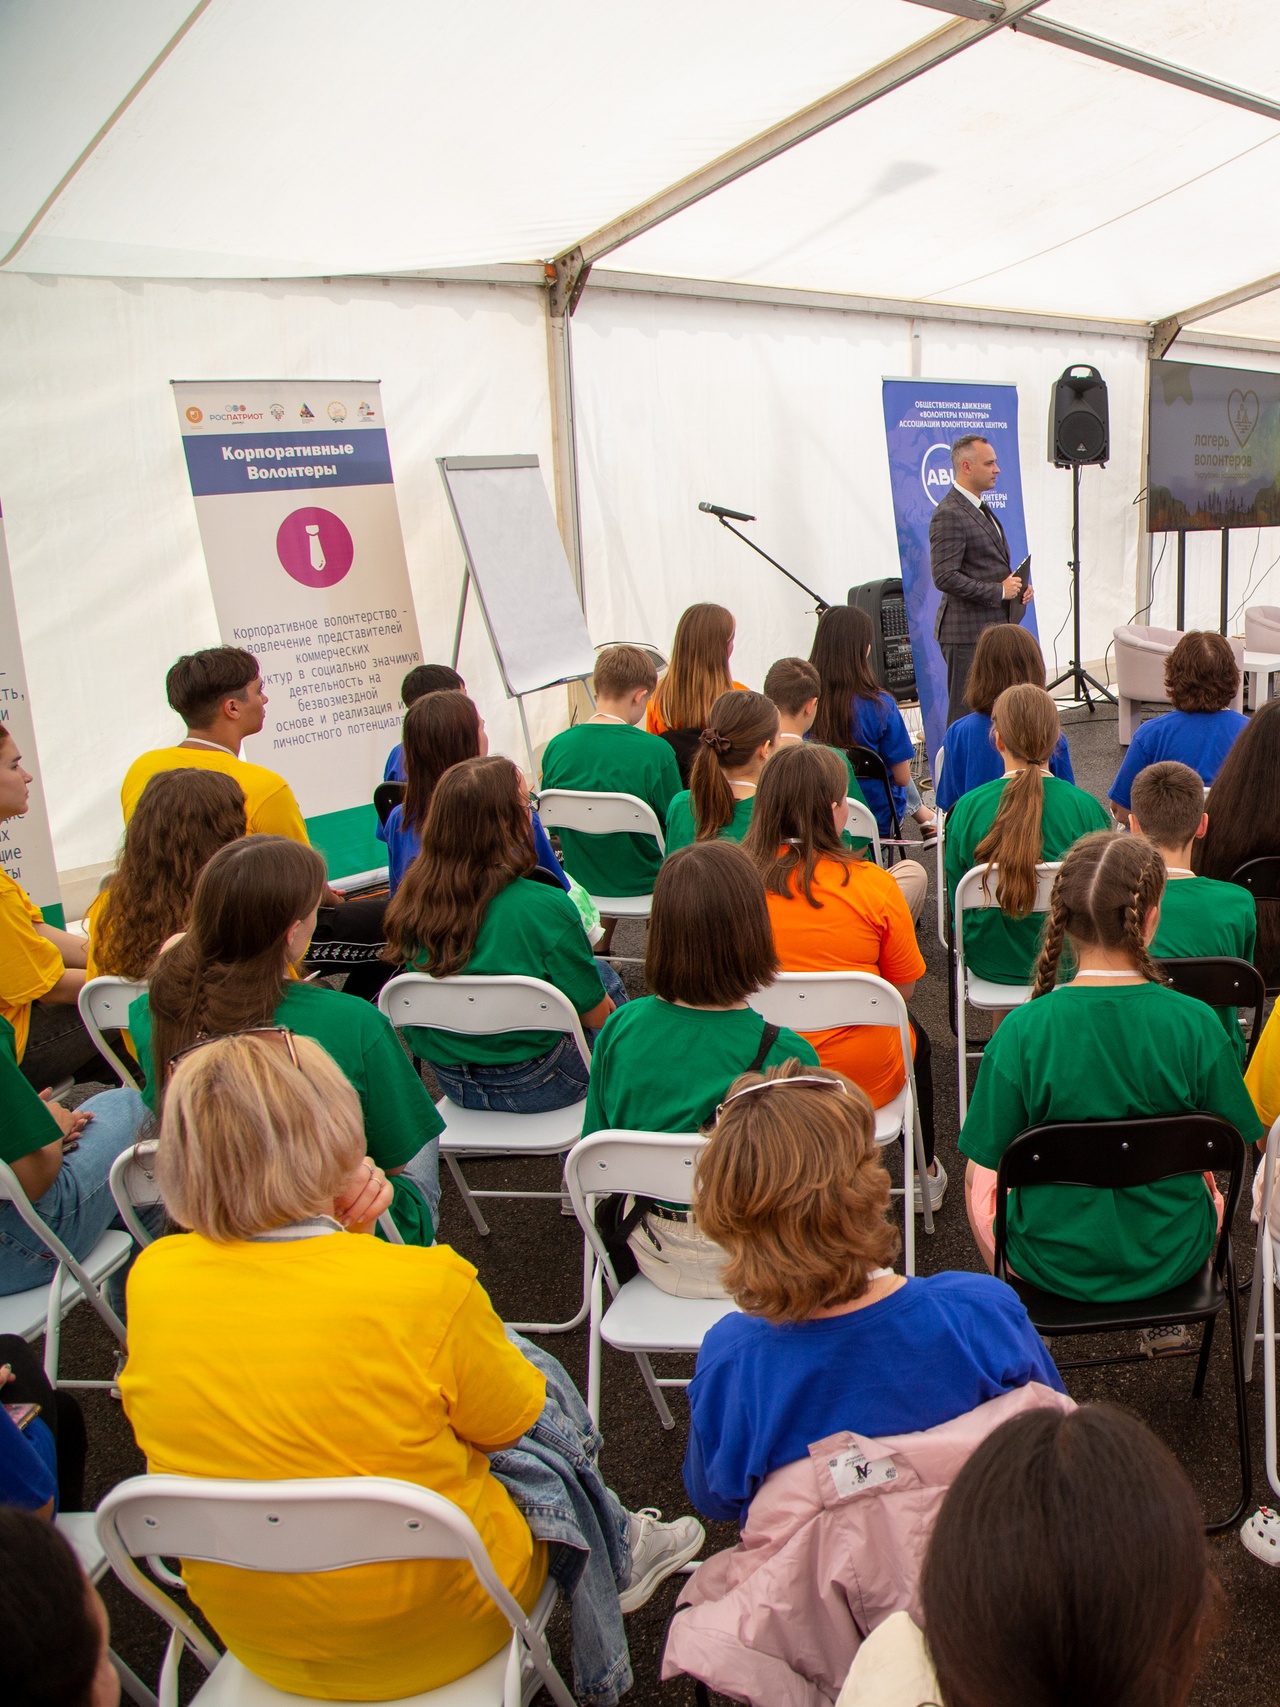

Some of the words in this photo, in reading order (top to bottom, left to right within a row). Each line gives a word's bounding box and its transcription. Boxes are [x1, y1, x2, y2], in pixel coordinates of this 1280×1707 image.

[914, 401, 961, 409] ОБЩЕСТВЕННОЕ
[961, 402, 992, 410] ДВИЖЕНИЕ
[919, 411, 957, 419] «ВОЛОНТЕРЫ
[959, 411, 989, 419] КУЛЬТУРЫ»
[209, 413, 264, 421] РОСПАТРИОТ
[899, 420, 941, 428] АССОЦИАЦИИ
[941, 420, 984, 428] ВОЛОНТЕРСКИХ
[985, 421, 1008, 429] ЦЕНТРОВ
[1194, 434, 1229, 451] лагерь
[221, 444, 354, 462] Корпоративные
[1194, 454, 1252, 470] волонтеров
[247, 464, 337, 480] Волонтеры
[233, 619, 318, 641] Корпоративное
[324, 608, 397, 627] волонтерство
[247, 636, 312, 654] вовлечение
[318, 621, 403, 646] представителей
[296, 643, 370, 663] коммерческих
[298, 670, 305, 679] в
[312, 659, 366, 678] социально
[373, 651, 420, 668] значимую
[289, 677, 363, 699] деятельность
[369, 673, 381, 684] на
[298, 687, 378, 712] безвозмездной
[276, 714, 314, 732] основе
[320, 713, 327, 724] и
[333, 702, 392, 725] реализация
[273, 726, 342, 750] личностного
